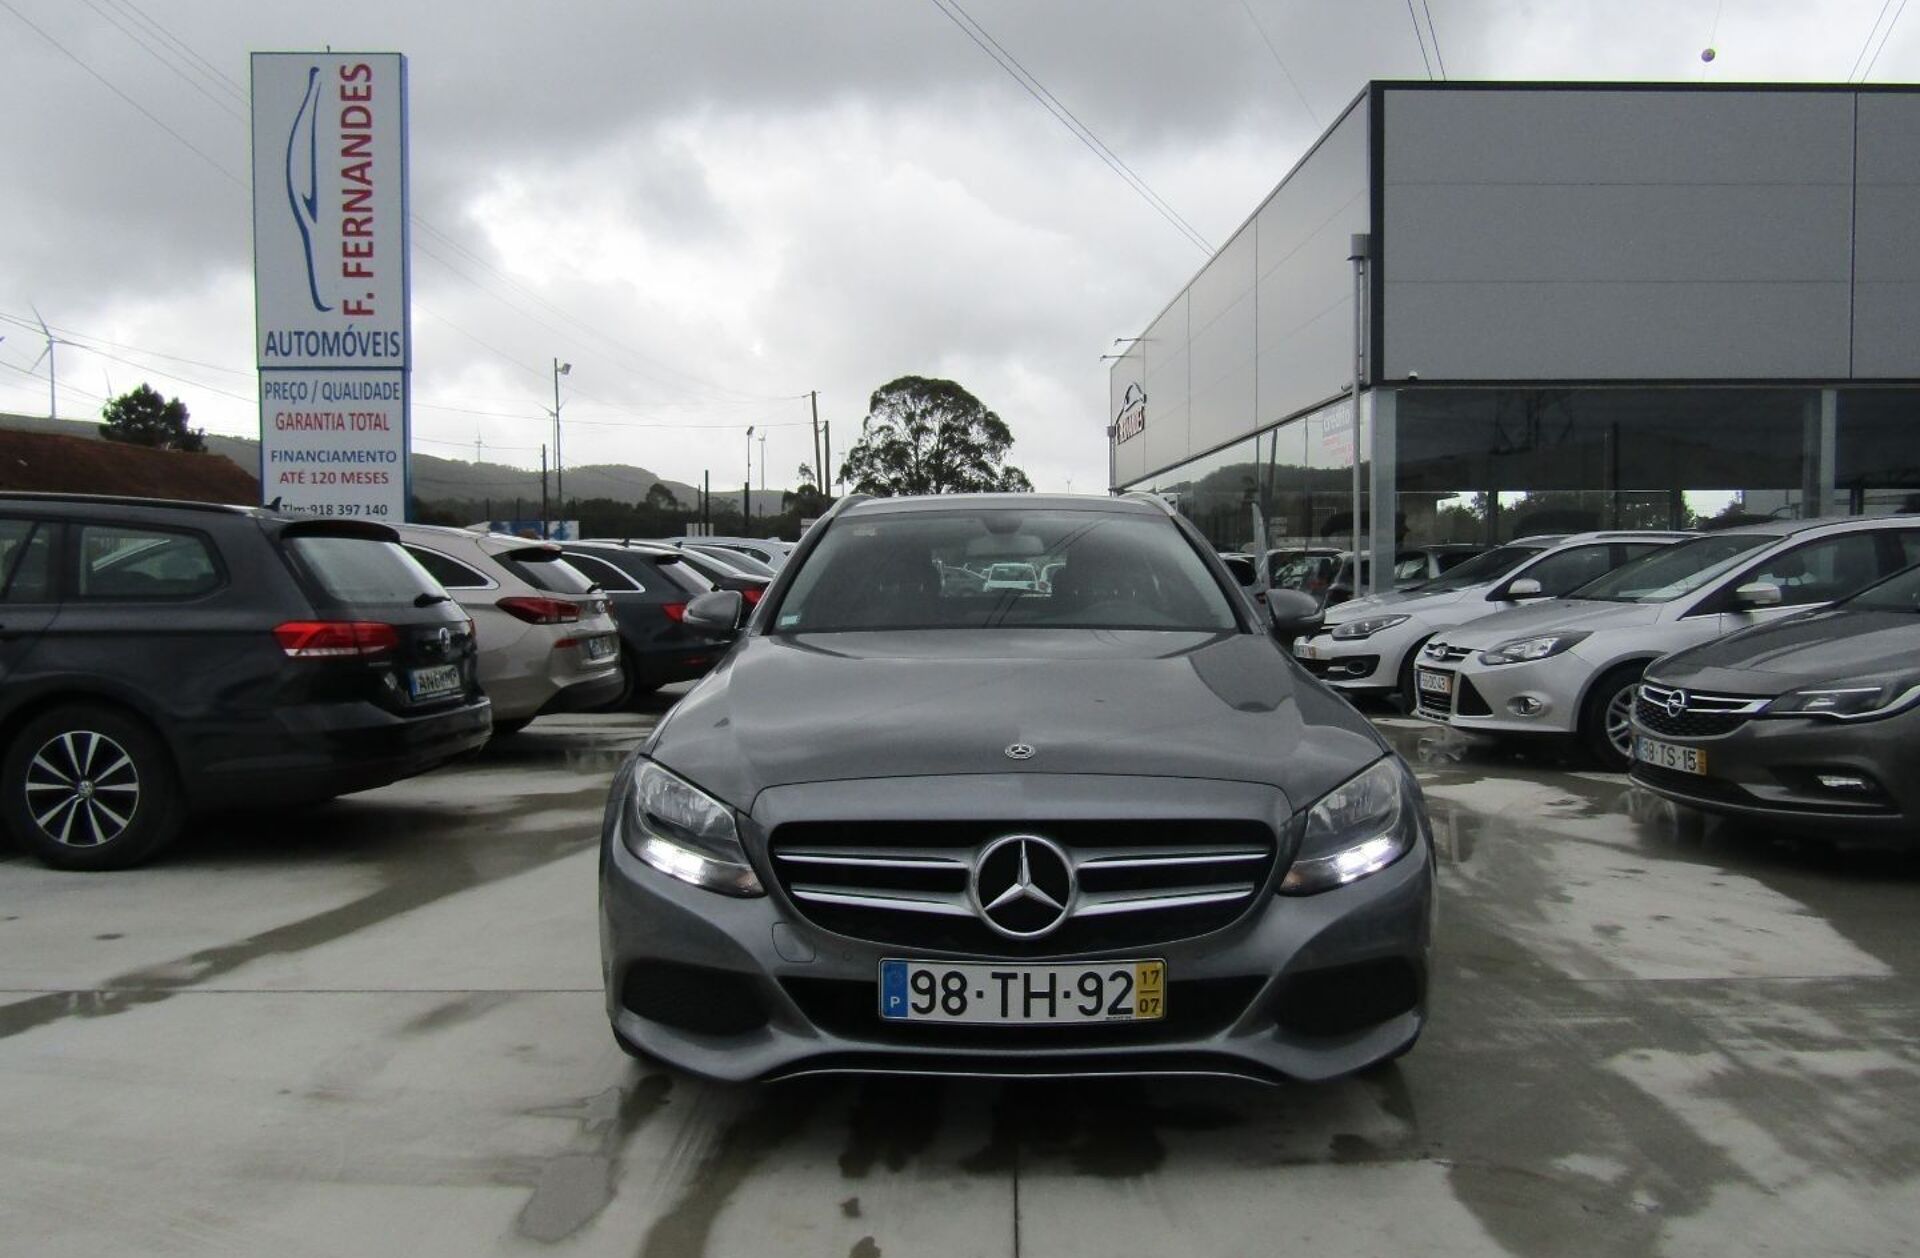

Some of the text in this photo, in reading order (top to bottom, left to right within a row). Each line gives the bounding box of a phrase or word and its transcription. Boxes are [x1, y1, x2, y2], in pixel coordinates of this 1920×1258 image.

[340, 63, 374, 316] F. FERNANDES
[265, 324, 400, 358] AUTOMÓVEIS
[265, 380, 400, 404] PREÇO / QUALIDADE
[275, 412, 390, 431] GARANTIA TOTAL
[271, 450, 396, 463] FINANCIAMENTO
[312, 472, 336, 484] 120
[341, 472, 389, 484] MESES
[338, 505, 360, 516] 397
[365, 505, 388, 516] 140
[890, 996, 901, 1009] P
[1141, 970, 1160, 985] 17
[1140, 999, 1160, 1013] 07
